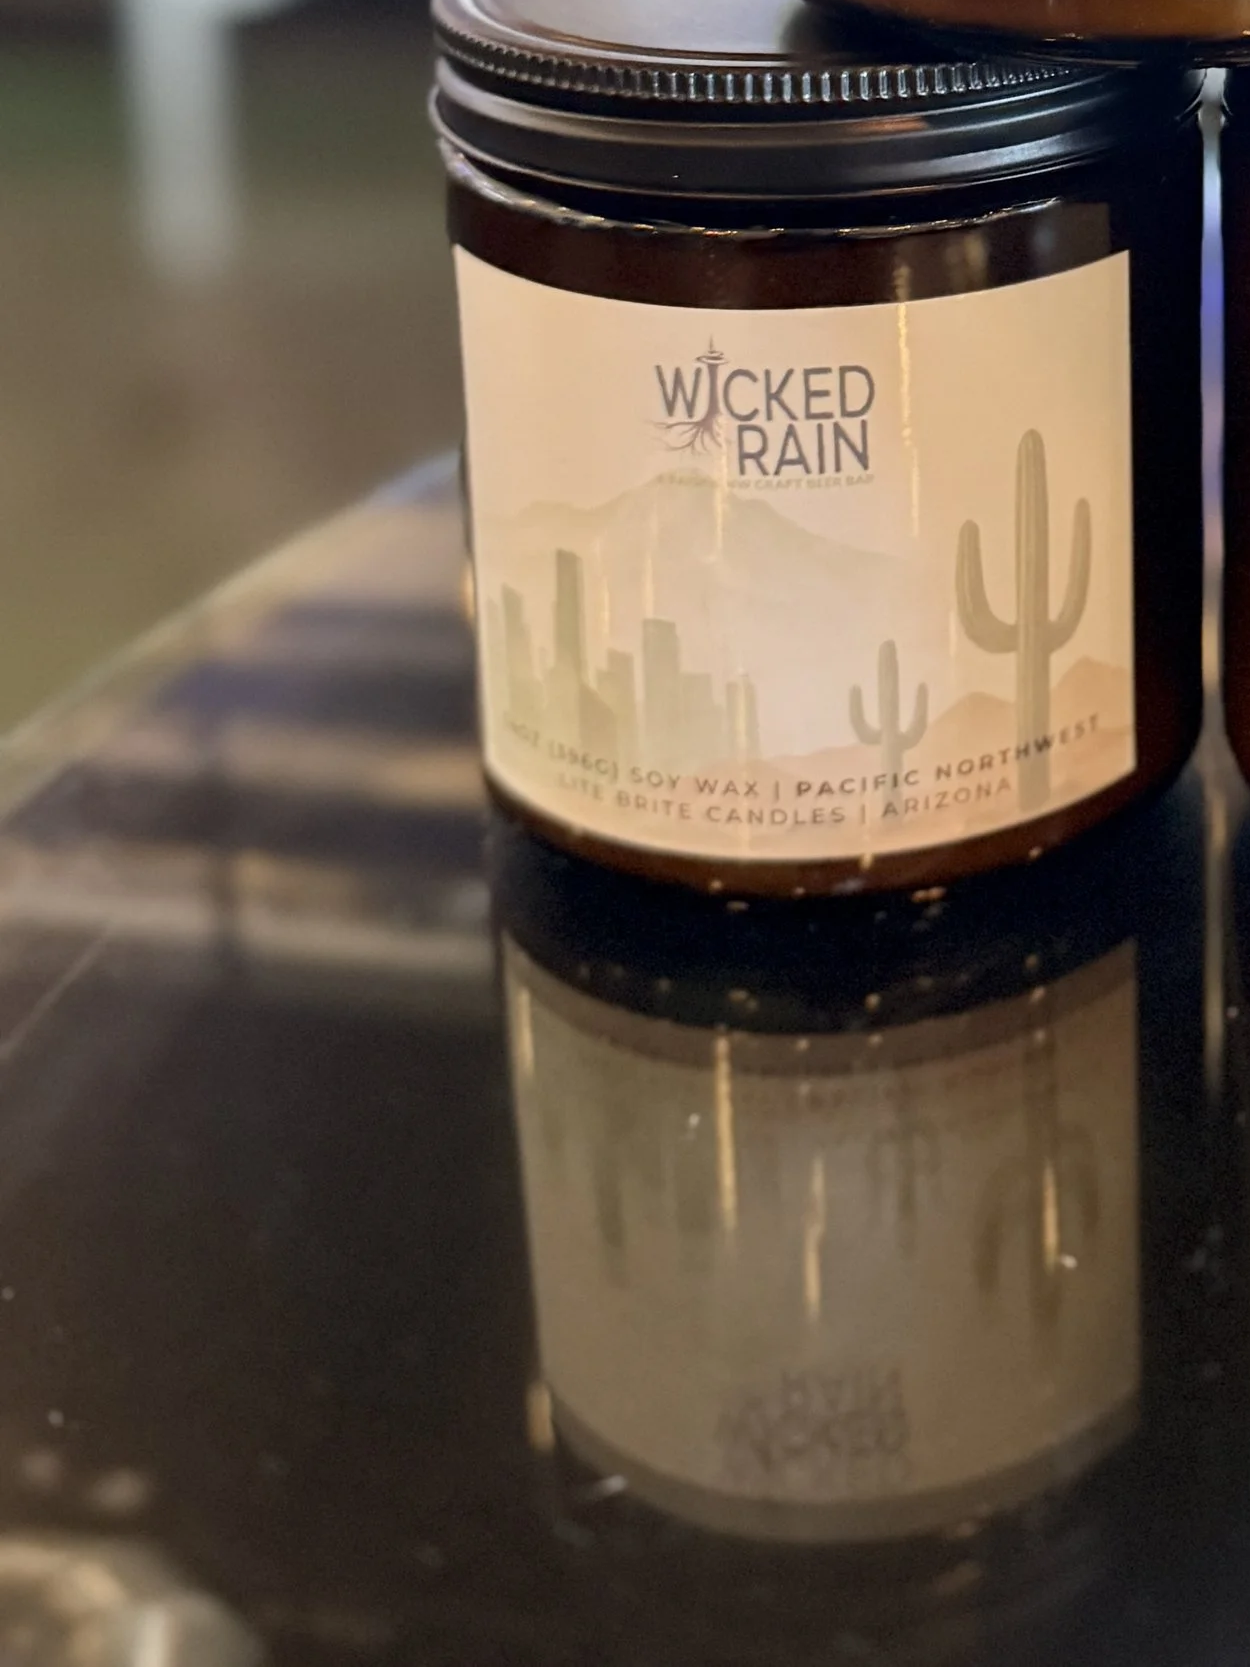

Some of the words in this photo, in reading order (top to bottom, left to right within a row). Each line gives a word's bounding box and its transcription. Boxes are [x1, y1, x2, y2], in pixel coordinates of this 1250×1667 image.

[655, 364, 876, 422] WICKED
[736, 419, 870, 477] RAIN
[630, 766, 682, 790] SOY
[696, 777, 760, 798] WAX
[796, 769, 921, 797] PACIFIC
[935, 712, 1100, 782] NORTHWEST
[616, 790, 693, 821] BRITE
[705, 805, 847, 826] CANDLES
[880, 776, 1012, 819] ARIZONA
